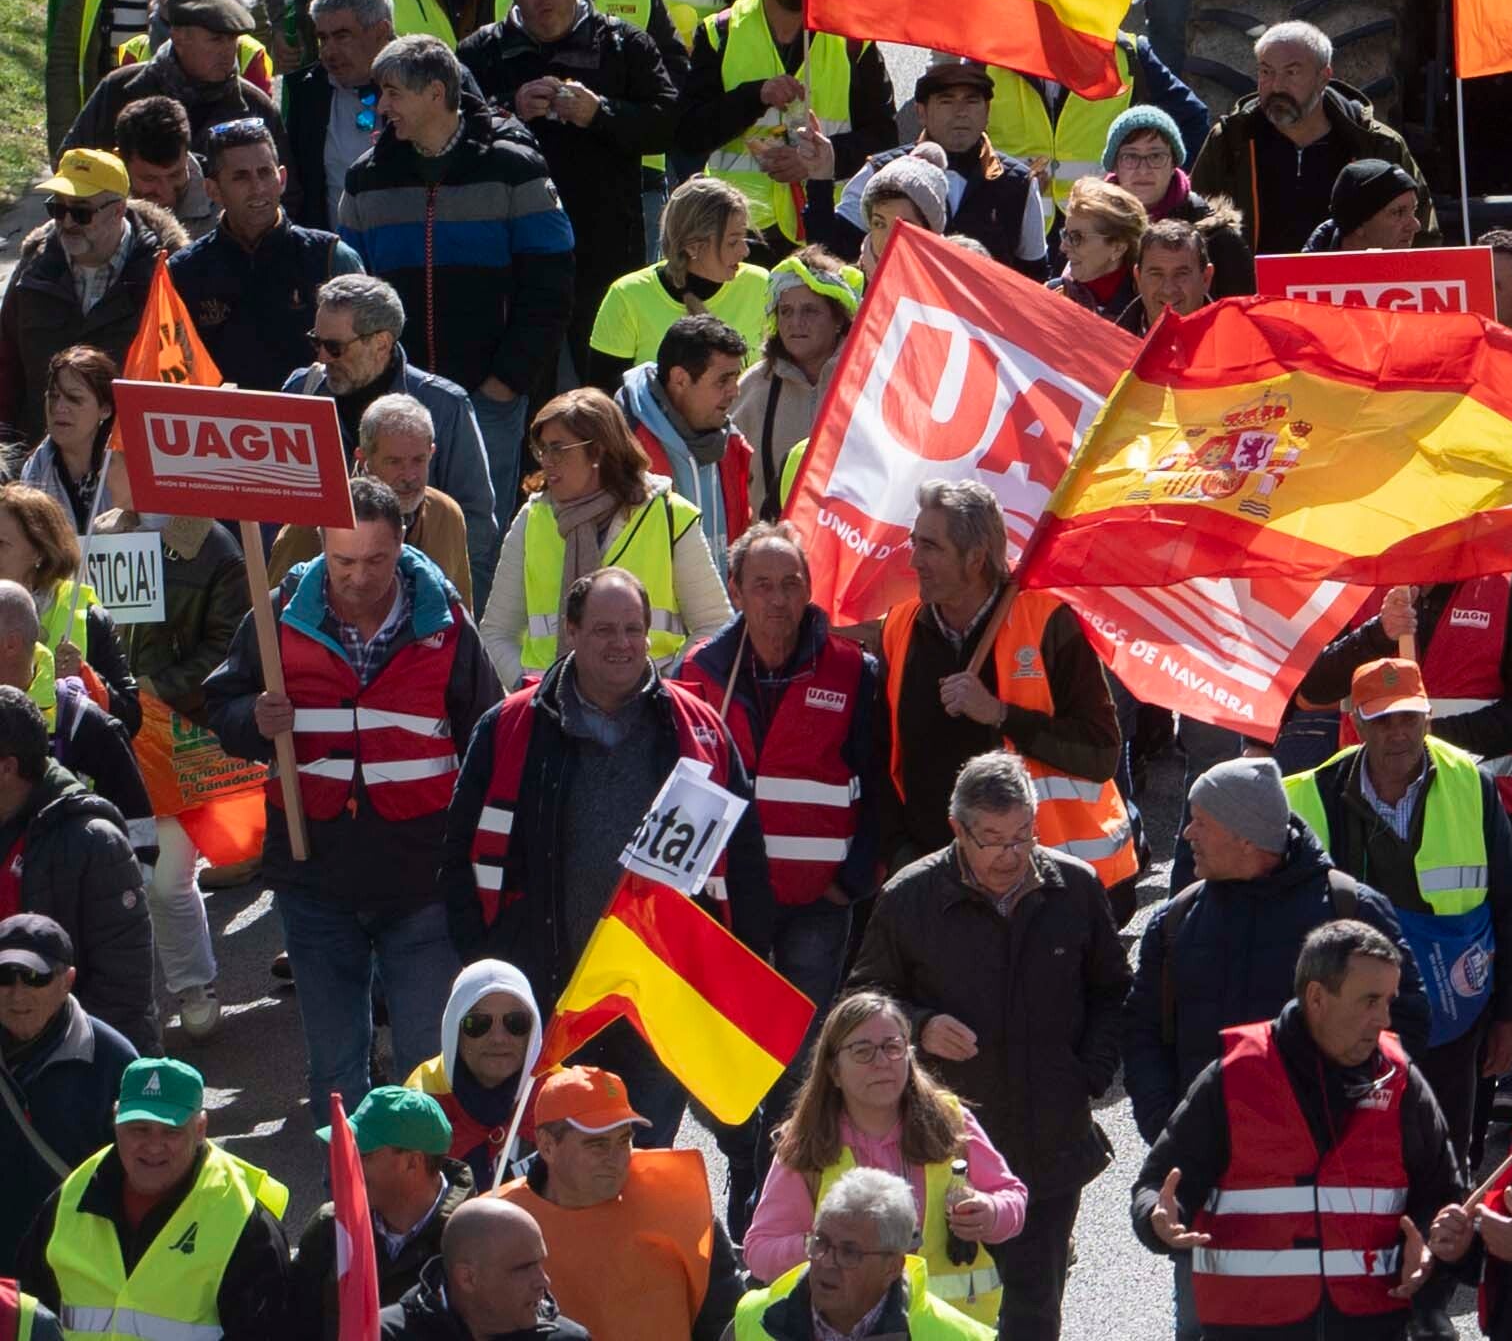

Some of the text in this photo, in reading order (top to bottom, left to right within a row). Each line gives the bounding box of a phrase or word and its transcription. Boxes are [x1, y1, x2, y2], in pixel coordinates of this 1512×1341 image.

[150, 417, 313, 467] UAGN
[816, 506, 886, 559] UNIÓN
[87, 550, 159, 604] STICIA!
[1453, 608, 1489, 622] UAGN
[808, 688, 847, 705] UAGN
[1127, 640, 1158, 666] DE
[1159, 649, 1256, 721] NAVARRA
[178, 760, 258, 785] Agricultor
